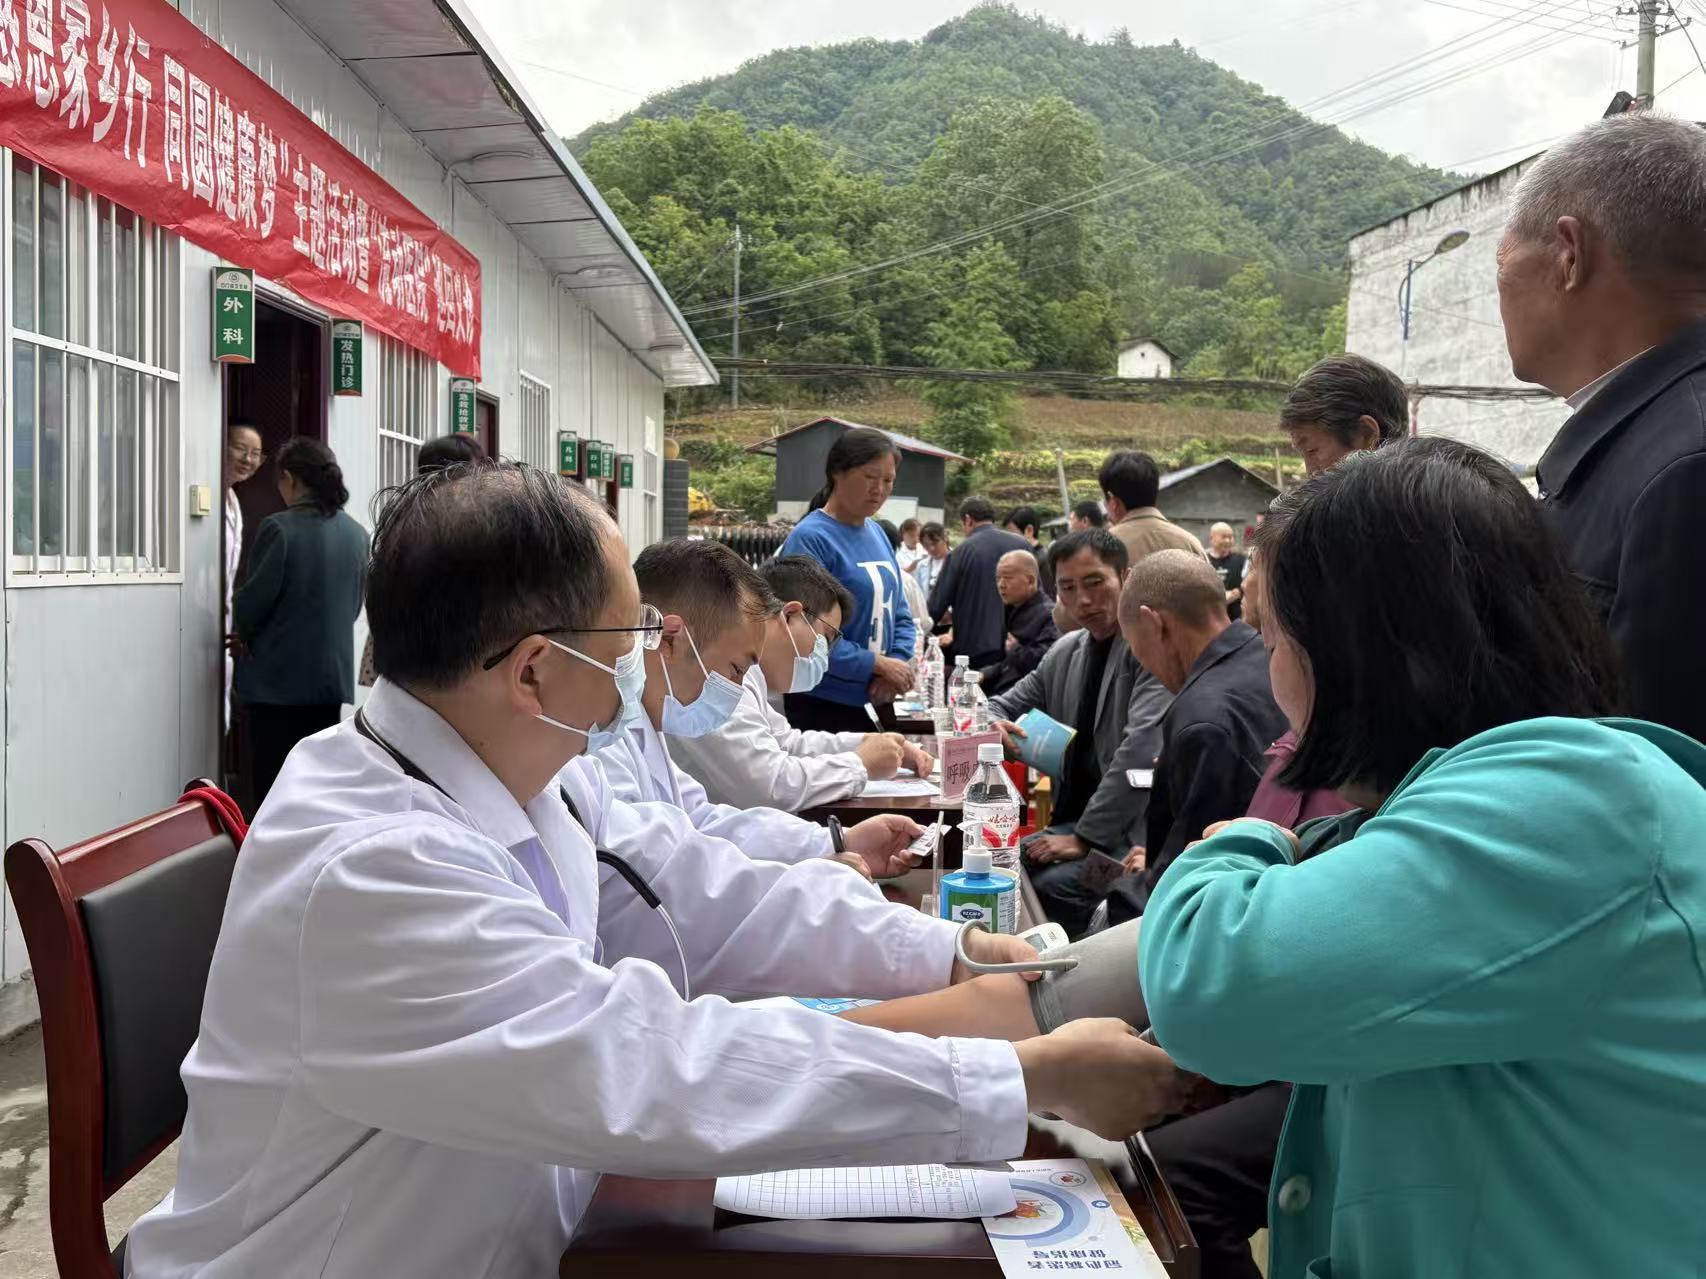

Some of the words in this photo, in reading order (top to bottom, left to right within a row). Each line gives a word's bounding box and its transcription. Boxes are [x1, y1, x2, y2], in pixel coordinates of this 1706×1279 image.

[223, 297, 244, 345] 外科
[341, 339, 354, 388] 发热门诊
